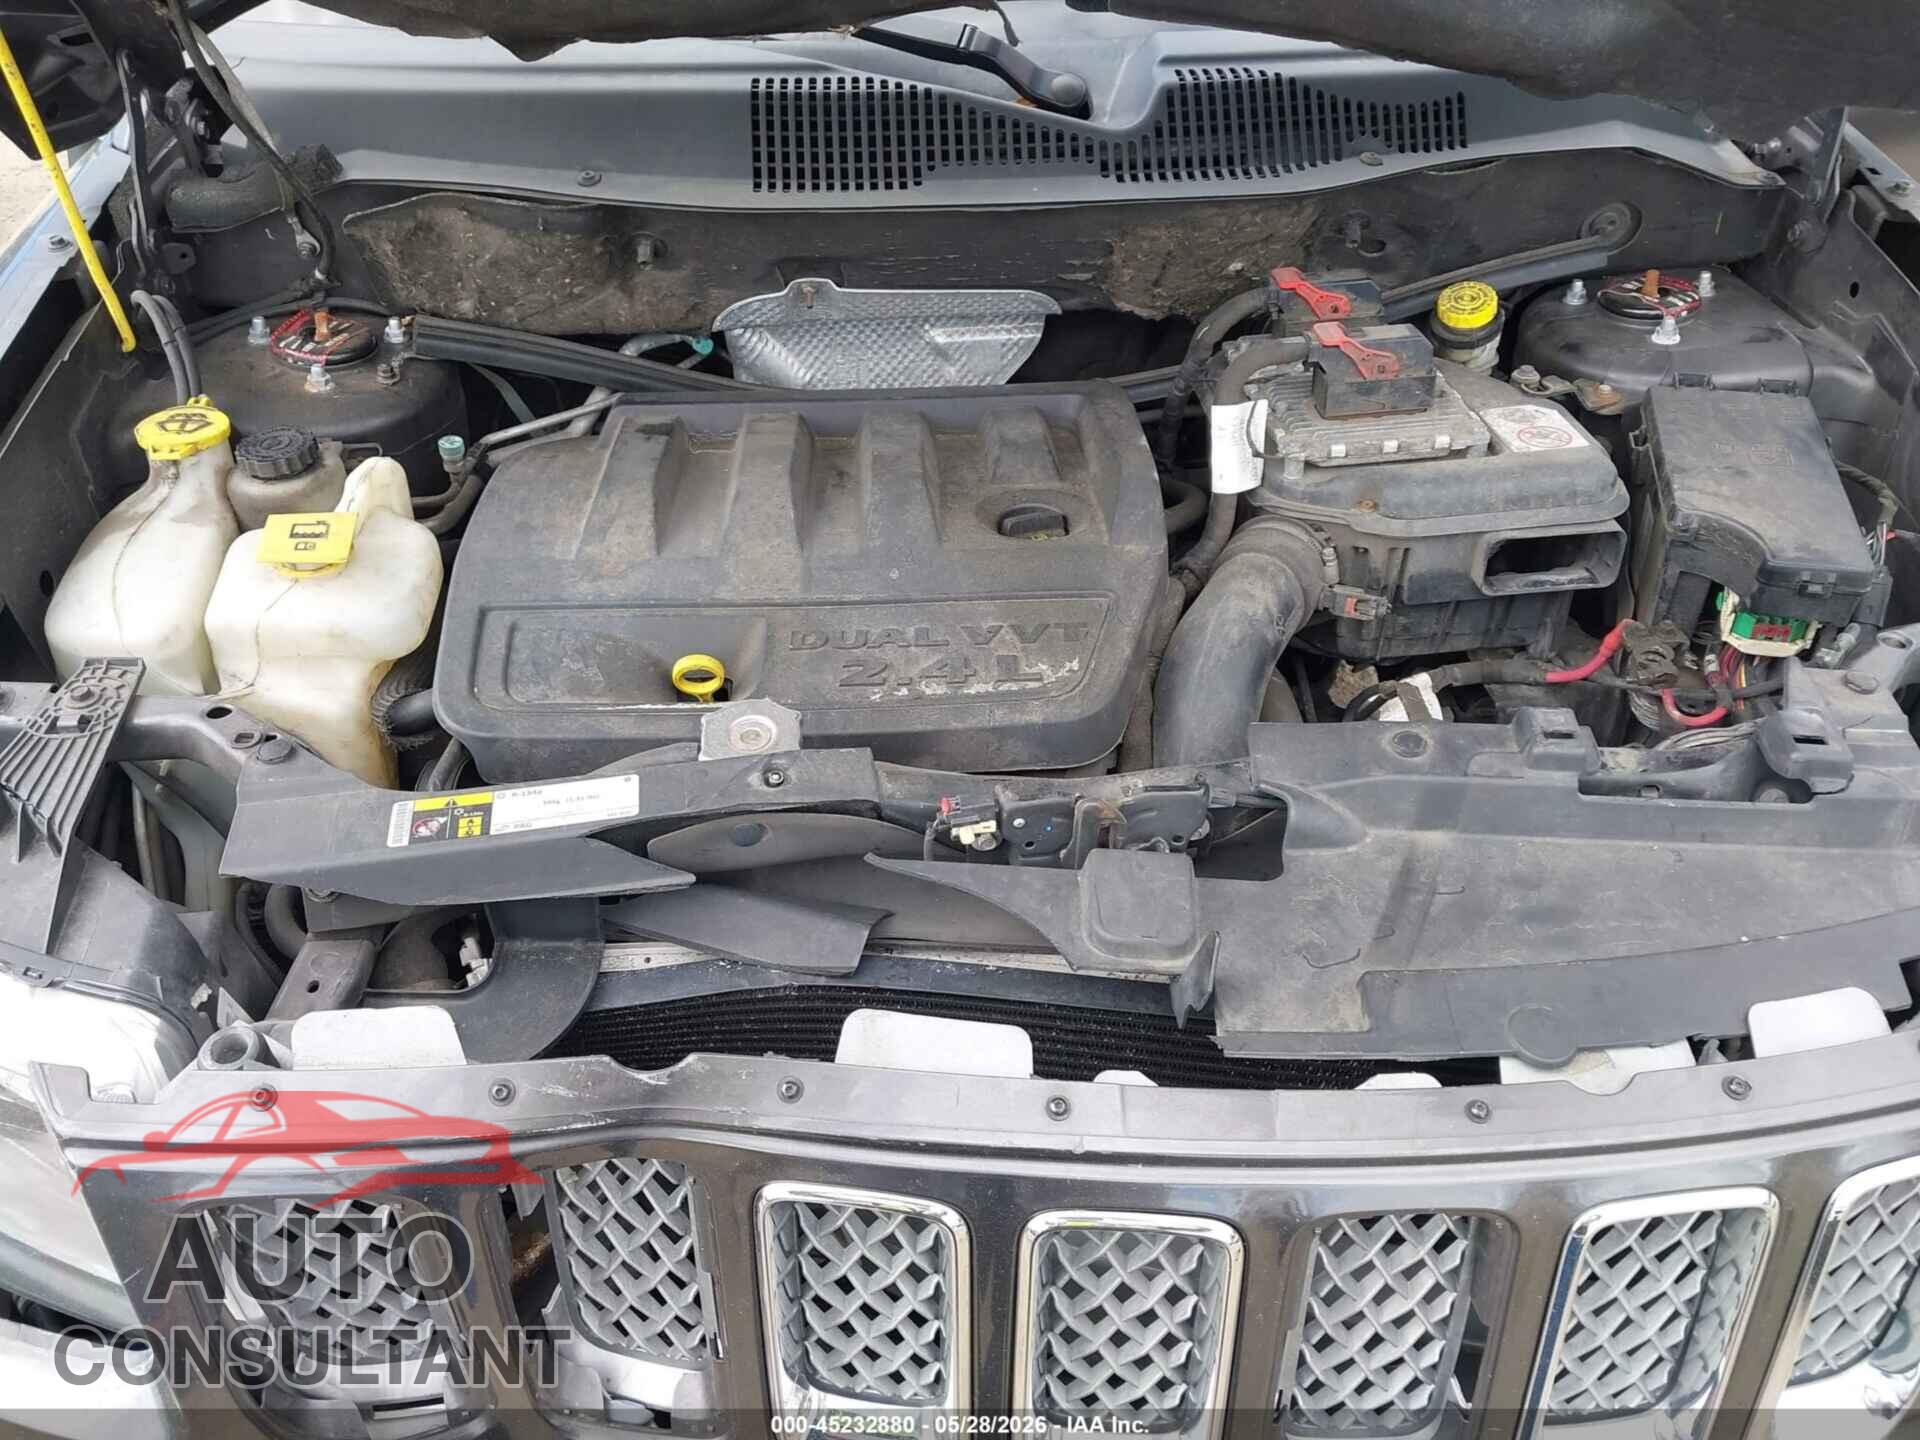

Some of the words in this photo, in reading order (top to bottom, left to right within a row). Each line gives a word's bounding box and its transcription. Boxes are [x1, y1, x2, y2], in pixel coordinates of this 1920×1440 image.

[788, 626, 950, 651] DUAL
[960, 622, 1090, 646] VVT
[837, 654, 1044, 688] 2.4L
